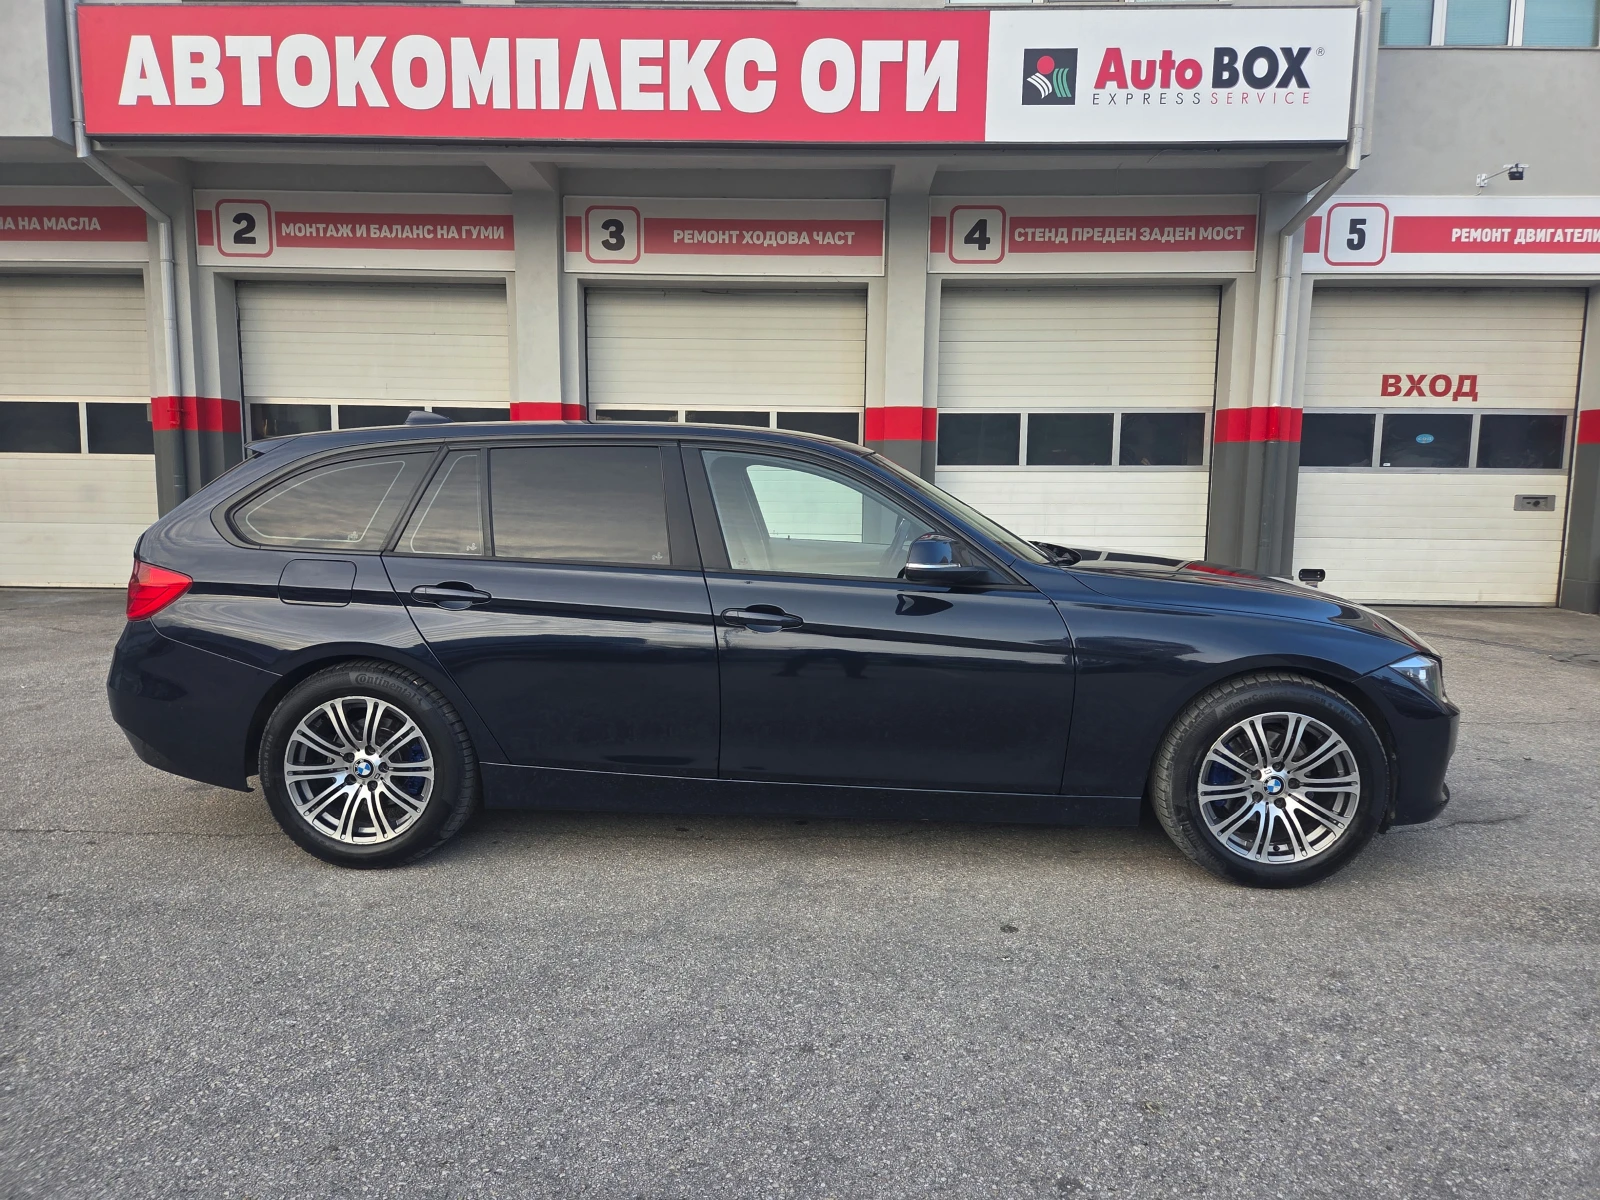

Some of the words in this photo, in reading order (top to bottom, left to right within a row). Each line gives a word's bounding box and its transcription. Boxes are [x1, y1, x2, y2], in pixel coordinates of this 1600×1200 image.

[118, 34, 777, 114] АВТОКОМПЛЕКС
[801, 37, 960, 114] ОГИ
[1093, 47, 1203, 90] Auto
[1211, 45, 1312, 90] BOX
[1092, 92, 1201, 106] EXPRESS
[1210, 91, 1310, 105] SERVICE
[17, 216, 42, 230] НА
[43, 216, 102, 231] МАСЛА
[232, 212, 257, 245] 2
[281, 222, 354, 238] МОНТАЖ
[355, 223, 368, 238] И
[369, 224, 434, 239] БАЛАНС
[437, 225, 460, 239] НА
[461, 225, 505, 240] ГУМИ
[601, 218, 626, 251] 3
[963, 218, 991, 251] 4
[1014, 227, 1069, 244] СТЕНД
[1071, 227, 1137, 244] ПРЕДЕН
[1139, 227, 1196, 244] ЗАДЕН
[1198, 226, 1245, 241] МОСТ
[1346, 218, 1367, 251] 5
[1451, 227, 1512, 243] РЕМОНТ
[1513, 227, 1600, 245] ДВИГАТЕЛИ
[673, 229, 740, 245] РЕМОНТ
[742, 230, 811, 247] ХОДОВА
[812, 231, 856, 246] ЧАСТ
[1380, 374, 1479, 402] ВХОД
[355, 673, 417, 700] Continental
